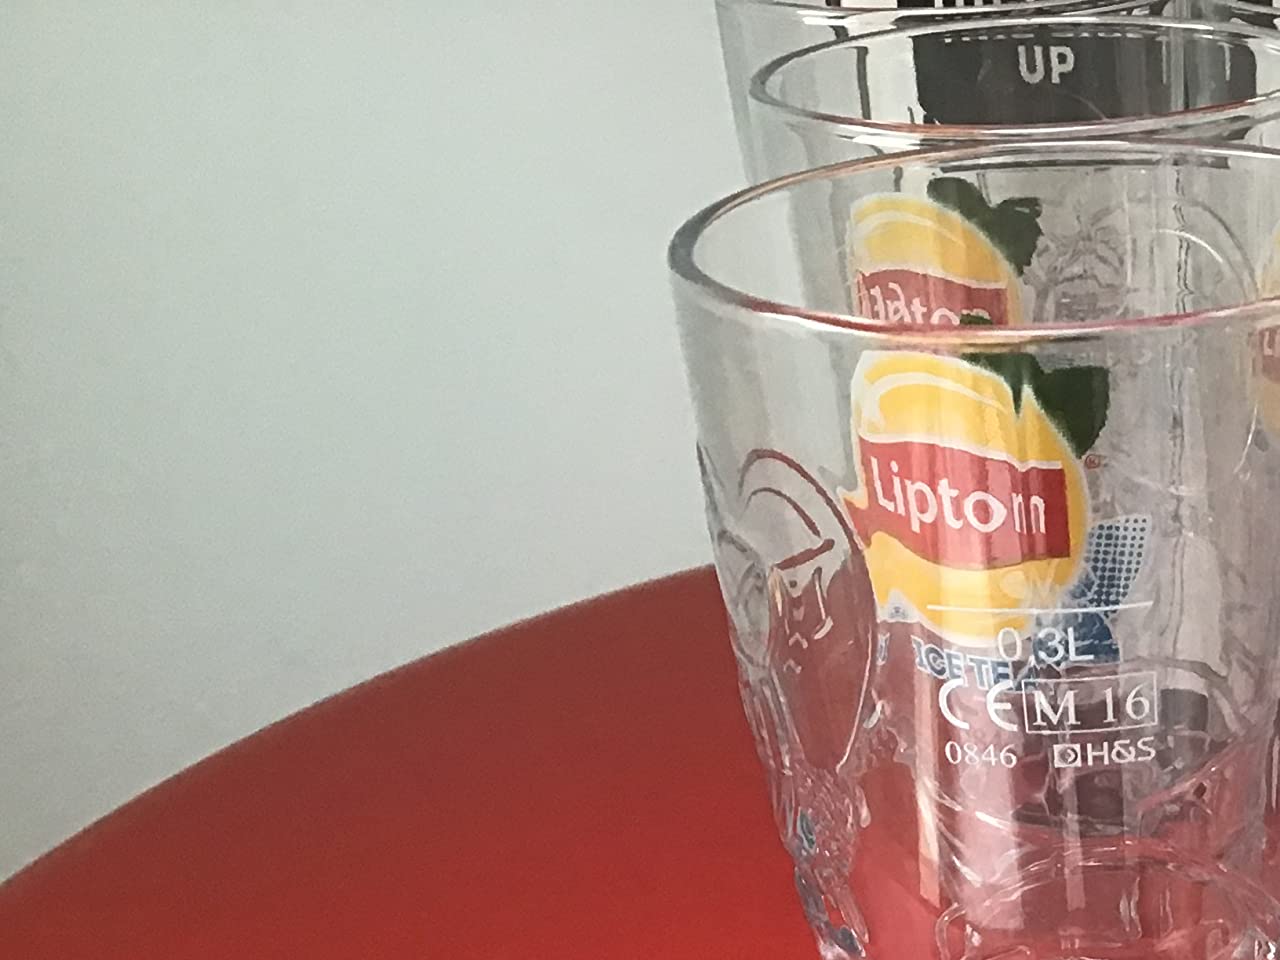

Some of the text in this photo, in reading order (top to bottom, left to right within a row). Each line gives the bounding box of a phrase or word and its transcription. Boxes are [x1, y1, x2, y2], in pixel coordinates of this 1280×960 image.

[1018, 45, 1075, 84] UP
[869, 456, 1047, 534] Lipton
[944, 741, 1018, 768] 0846
